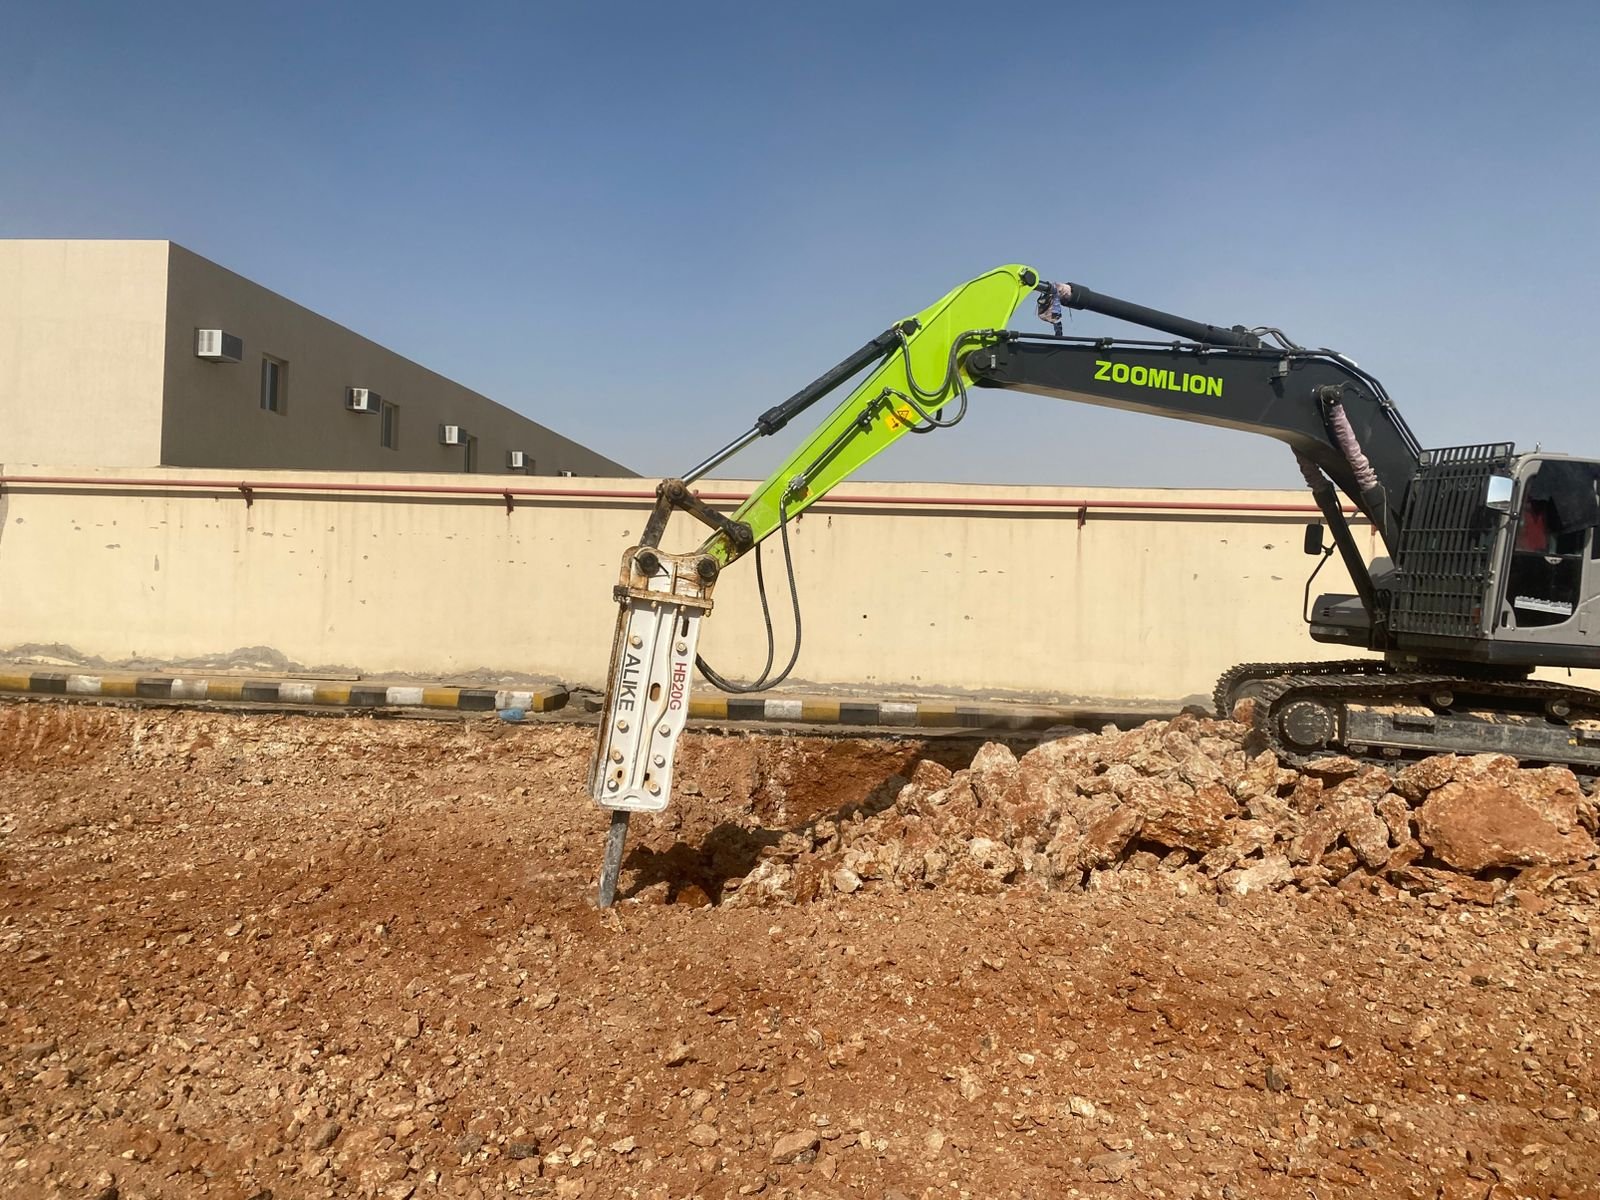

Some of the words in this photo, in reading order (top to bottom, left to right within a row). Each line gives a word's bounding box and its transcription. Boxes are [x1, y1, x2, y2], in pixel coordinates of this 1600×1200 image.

[1094, 360, 1223, 397] ZOOMLION
[618, 653, 641, 712] ALIKE
[669, 662, 687, 710] HB20G
